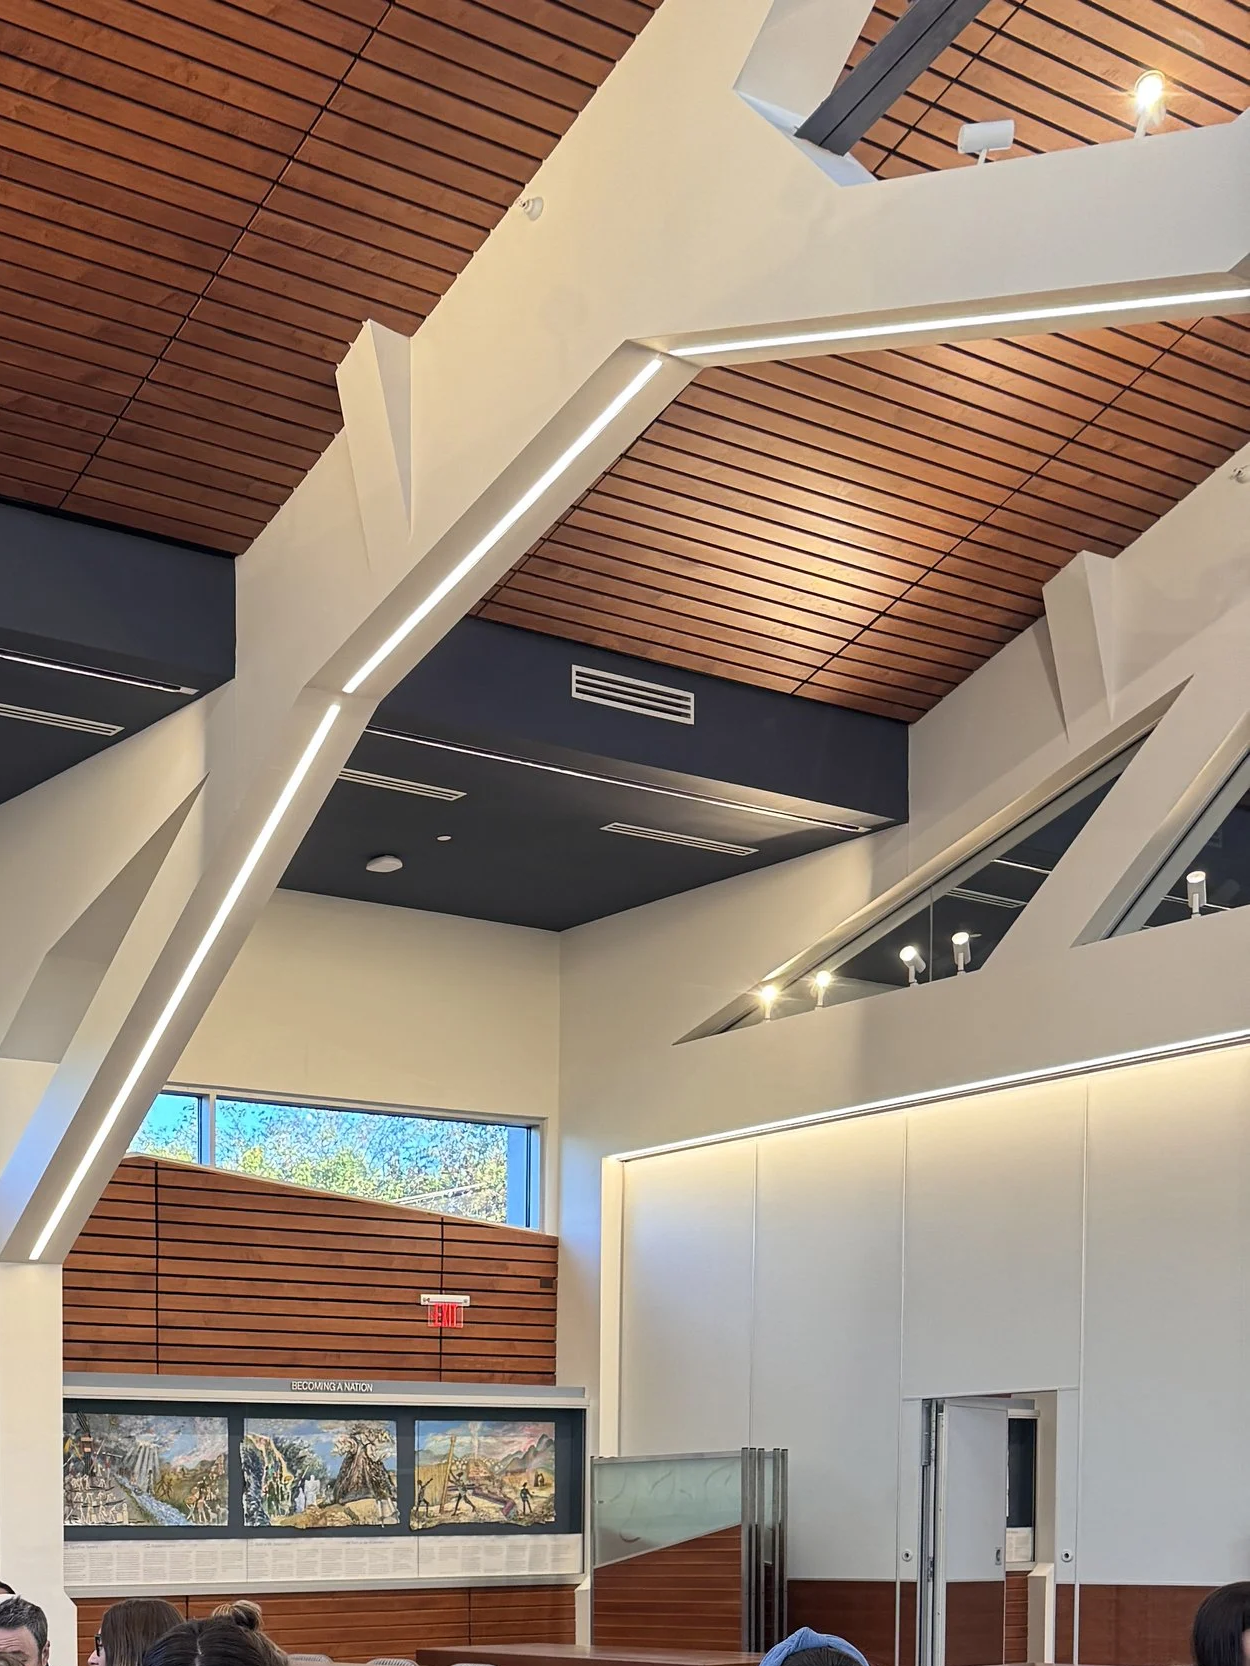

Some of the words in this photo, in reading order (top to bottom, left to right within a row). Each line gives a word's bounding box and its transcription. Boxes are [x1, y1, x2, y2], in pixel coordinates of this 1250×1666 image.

[433, 1302, 458, 1327] EXIT
[291, 1381, 336, 1391] BECOMING
[336, 1382, 343, 1391] A
[344, 1382, 373, 1392] NATION
